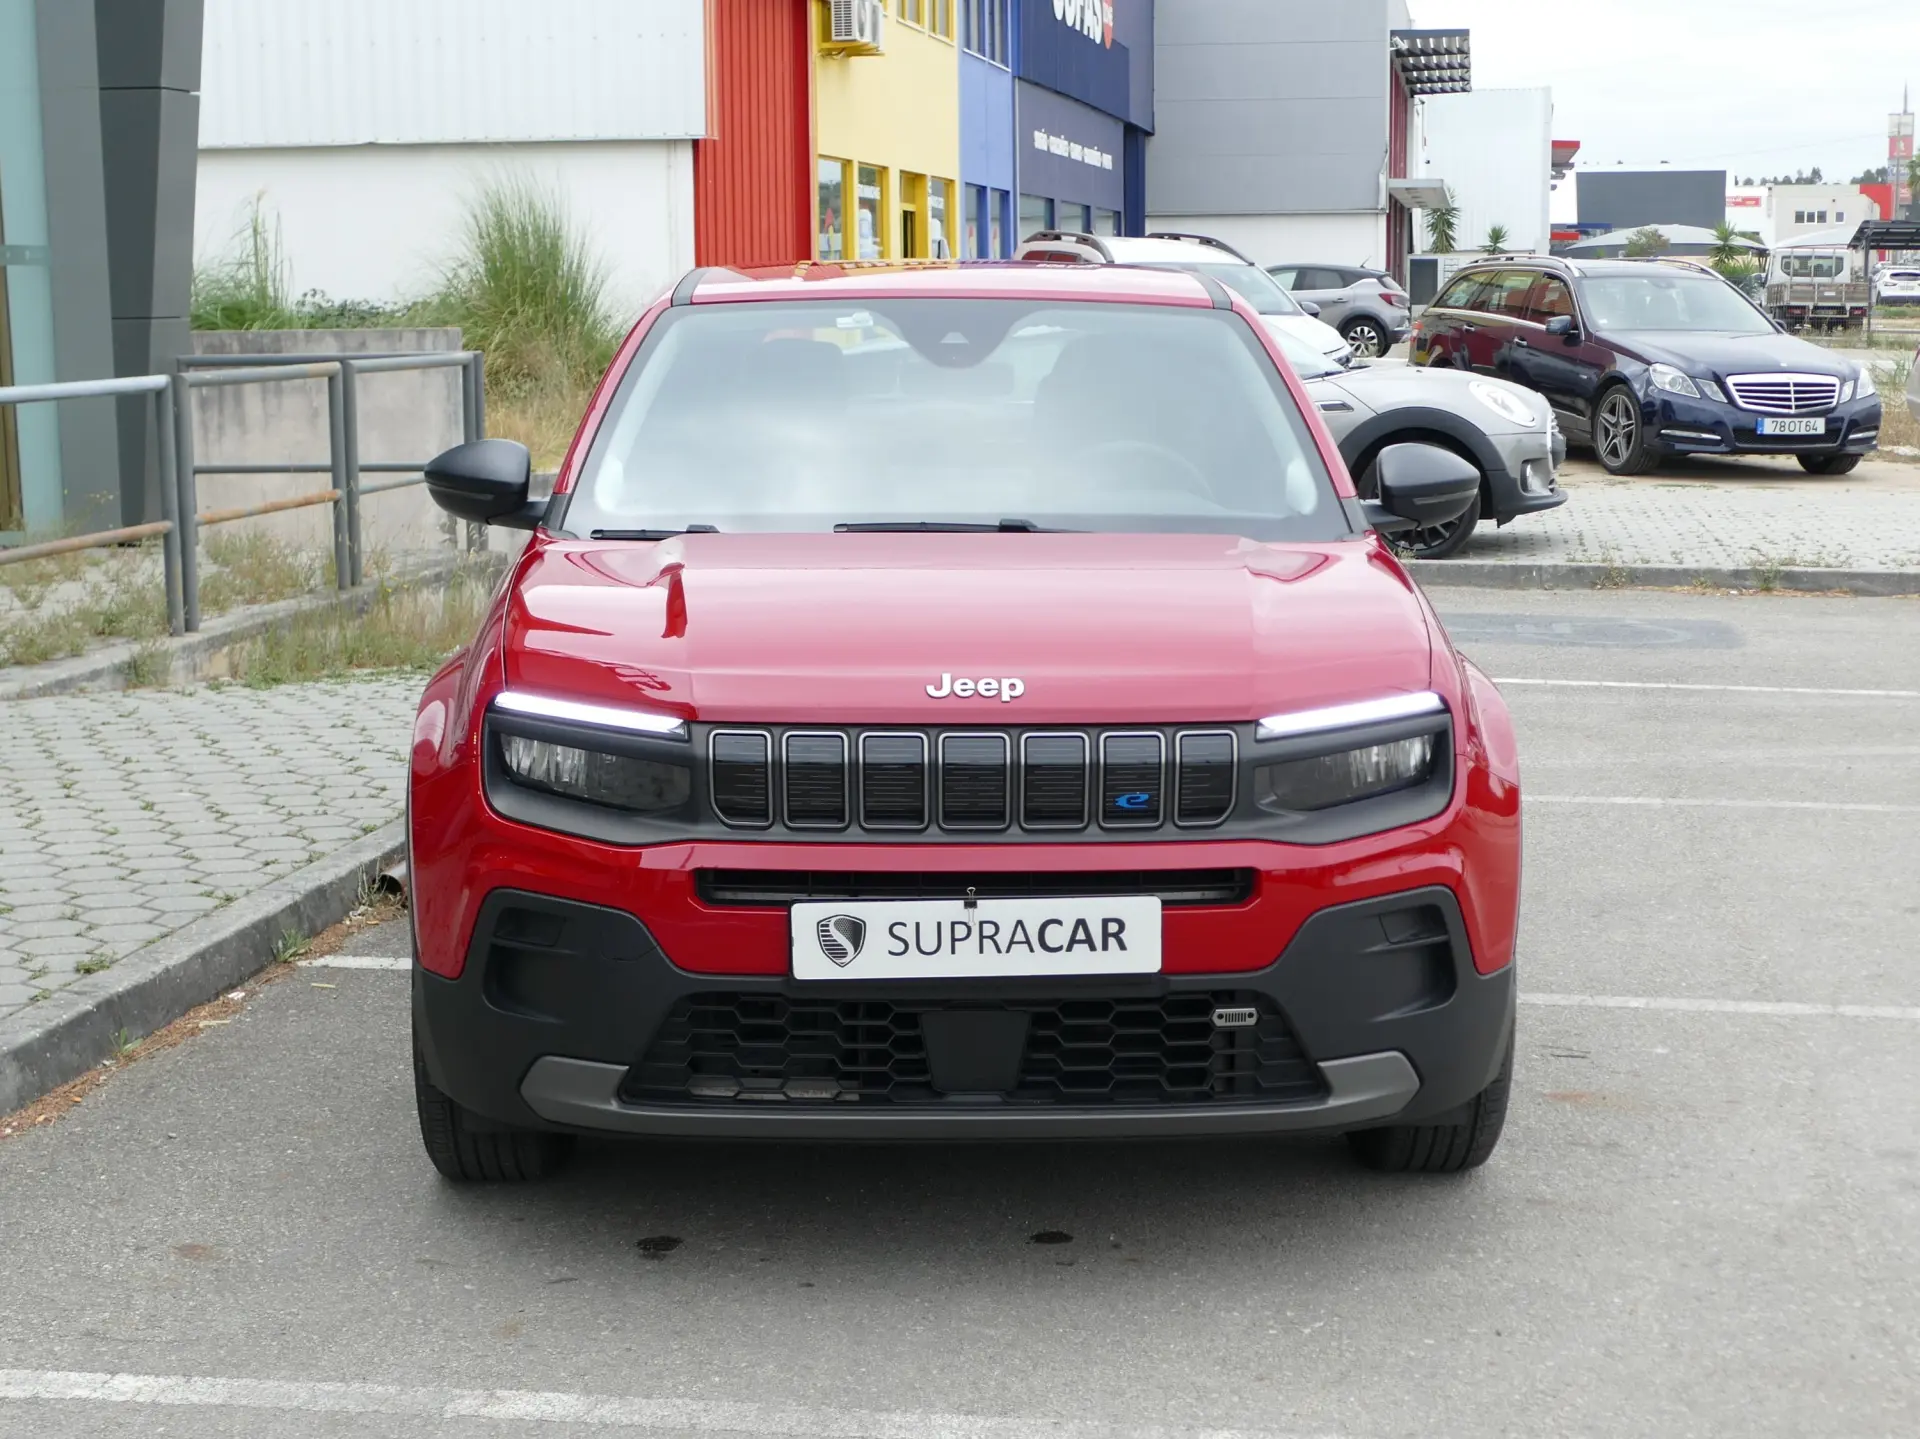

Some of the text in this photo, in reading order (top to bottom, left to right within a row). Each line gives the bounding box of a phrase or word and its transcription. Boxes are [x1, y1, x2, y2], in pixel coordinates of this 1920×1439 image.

[1771, 420, 1818, 433] 78OT64
[925, 672, 1025, 703] Jeep
[887, 916, 1128, 957] SUPRACAR
